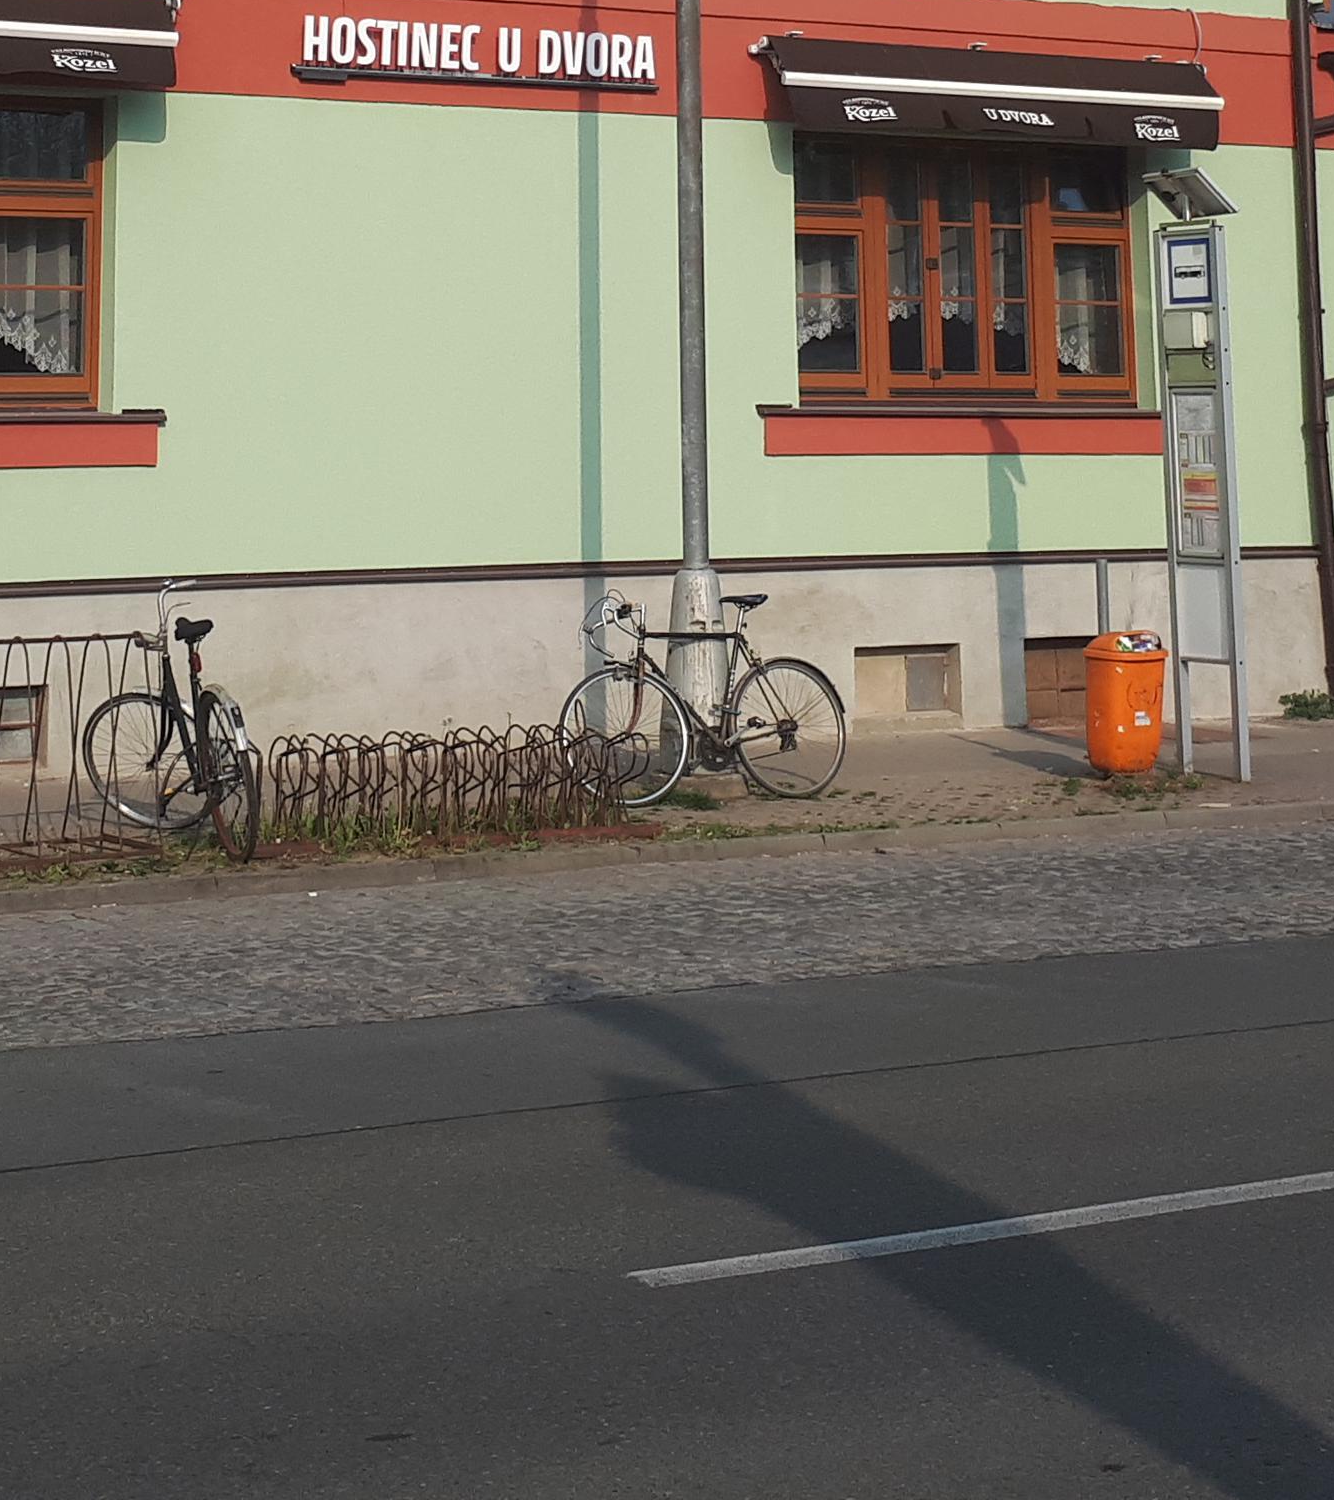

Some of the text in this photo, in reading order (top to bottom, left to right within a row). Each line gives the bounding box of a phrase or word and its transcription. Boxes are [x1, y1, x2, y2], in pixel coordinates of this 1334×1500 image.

[302, 15, 657, 80] HOSTINEC U DVORA
[50, 54, 119, 73] Kozel
[843, 106, 898, 121] Kozel
[982, 108, 1055, 126] U DVORA
[1134, 123, 1181, 141] Kozel
